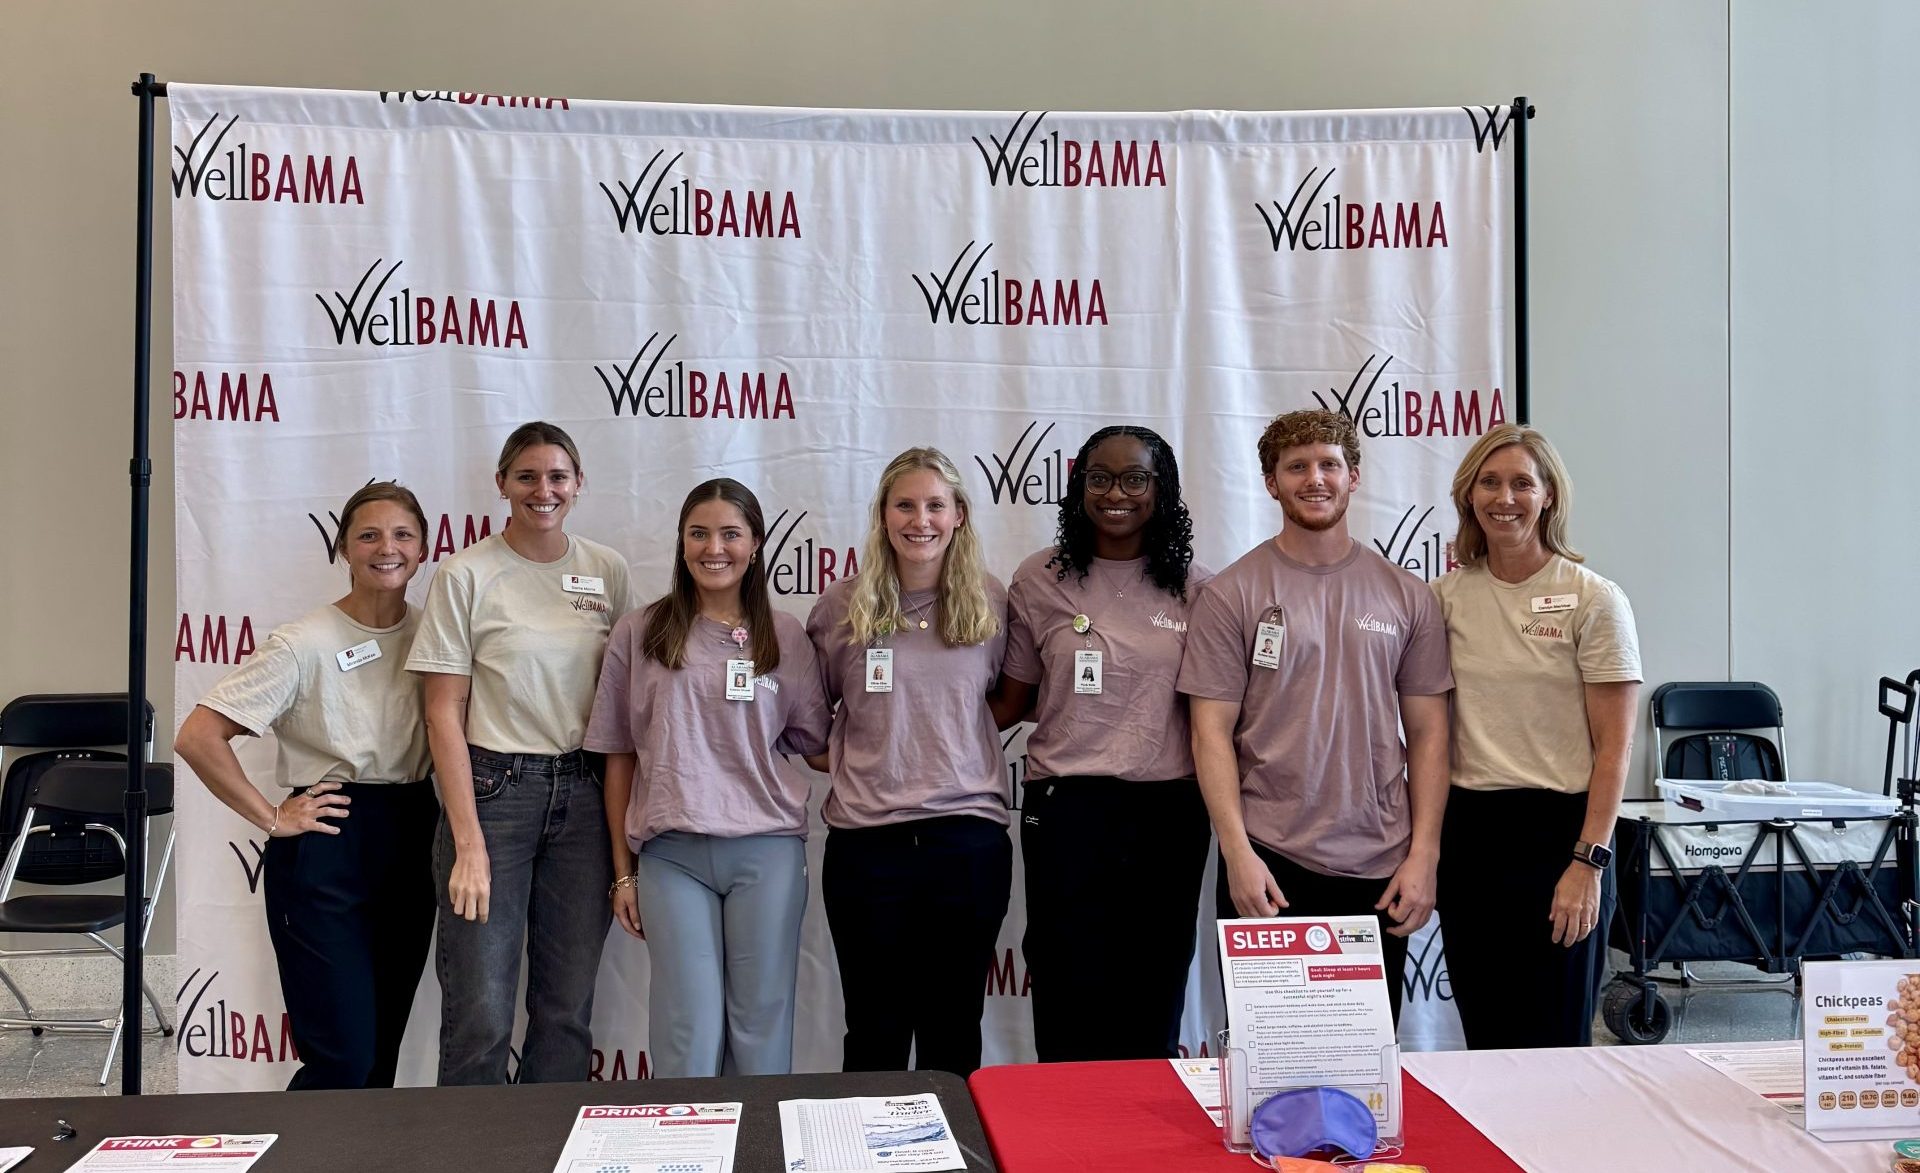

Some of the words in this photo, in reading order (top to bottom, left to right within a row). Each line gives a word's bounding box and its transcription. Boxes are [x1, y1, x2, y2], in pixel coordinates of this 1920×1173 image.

[172, 112, 364, 204] WellBAMA
[972, 110, 1166, 188] WellBAMA
[599, 148, 802, 239] WellBAMA
[1255, 166, 1448, 252] WellBAMA
[316, 258, 528, 349] WellBAMA
[912, 240, 1108, 326] WellBAMA
[594, 332, 796, 420] WellBAMA
[974, 420, 1077, 506] Well
[1355, 612, 1397, 637] WellBAMA
[1685, 845, 1742, 859] Homgava
[1232, 930, 1297, 949] SLEEP
[1816, 995, 1883, 1009] Chickpeas
[111, 1139, 180, 1148] THINK
[589, 1108, 662, 1117] DRINK
